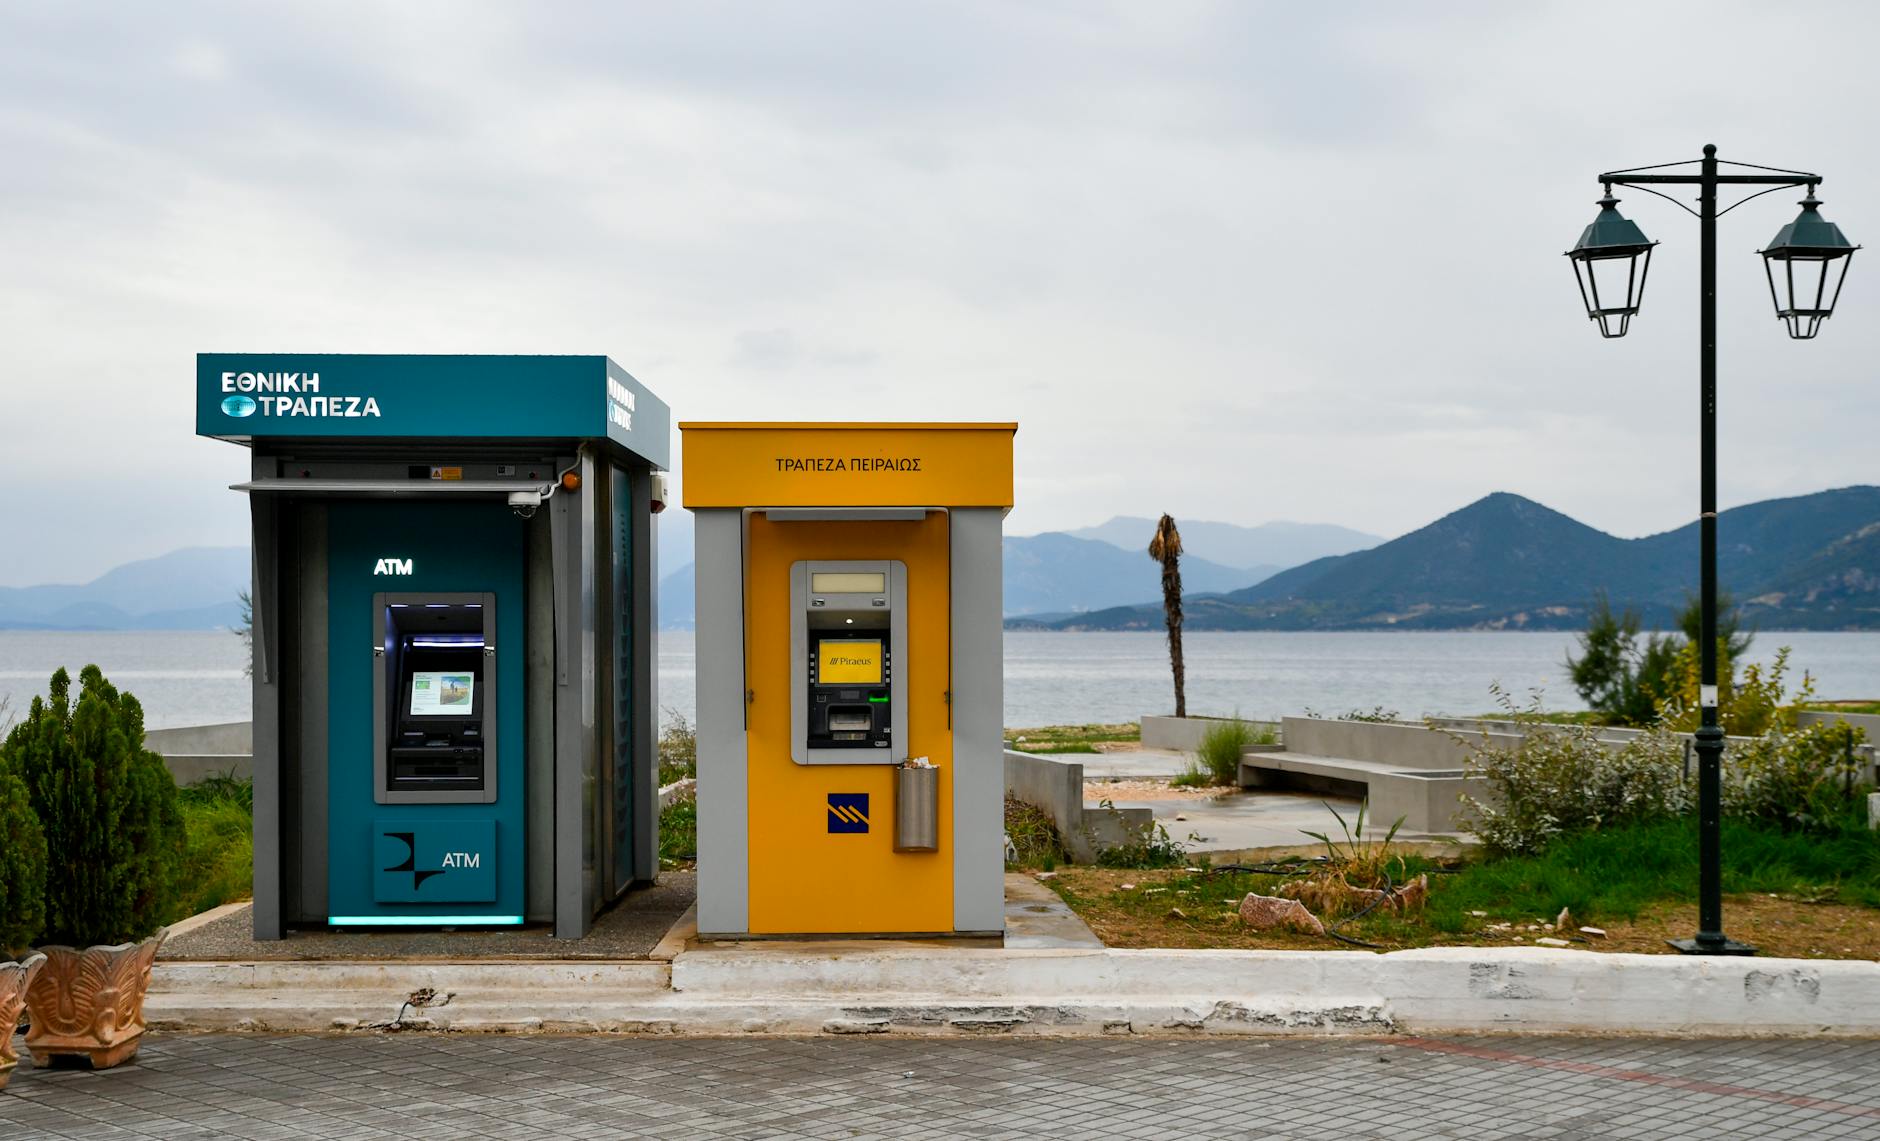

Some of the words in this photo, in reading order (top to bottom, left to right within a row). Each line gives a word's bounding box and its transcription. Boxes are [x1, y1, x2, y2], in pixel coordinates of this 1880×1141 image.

[221, 372, 320, 393] ΕΘΝΙΚΗ
[258, 396, 381, 417] ΤΡΑΠΕΖΑ
[776, 458, 846, 472] ΤΡΑΠΕΖΑ
[850, 458, 921, 472] ΠΕΙΡΑΙΩΣ
[373, 558, 413, 576] ATM
[840, 657, 872, 666] Piraeus
[442, 852, 480, 868] ATM
